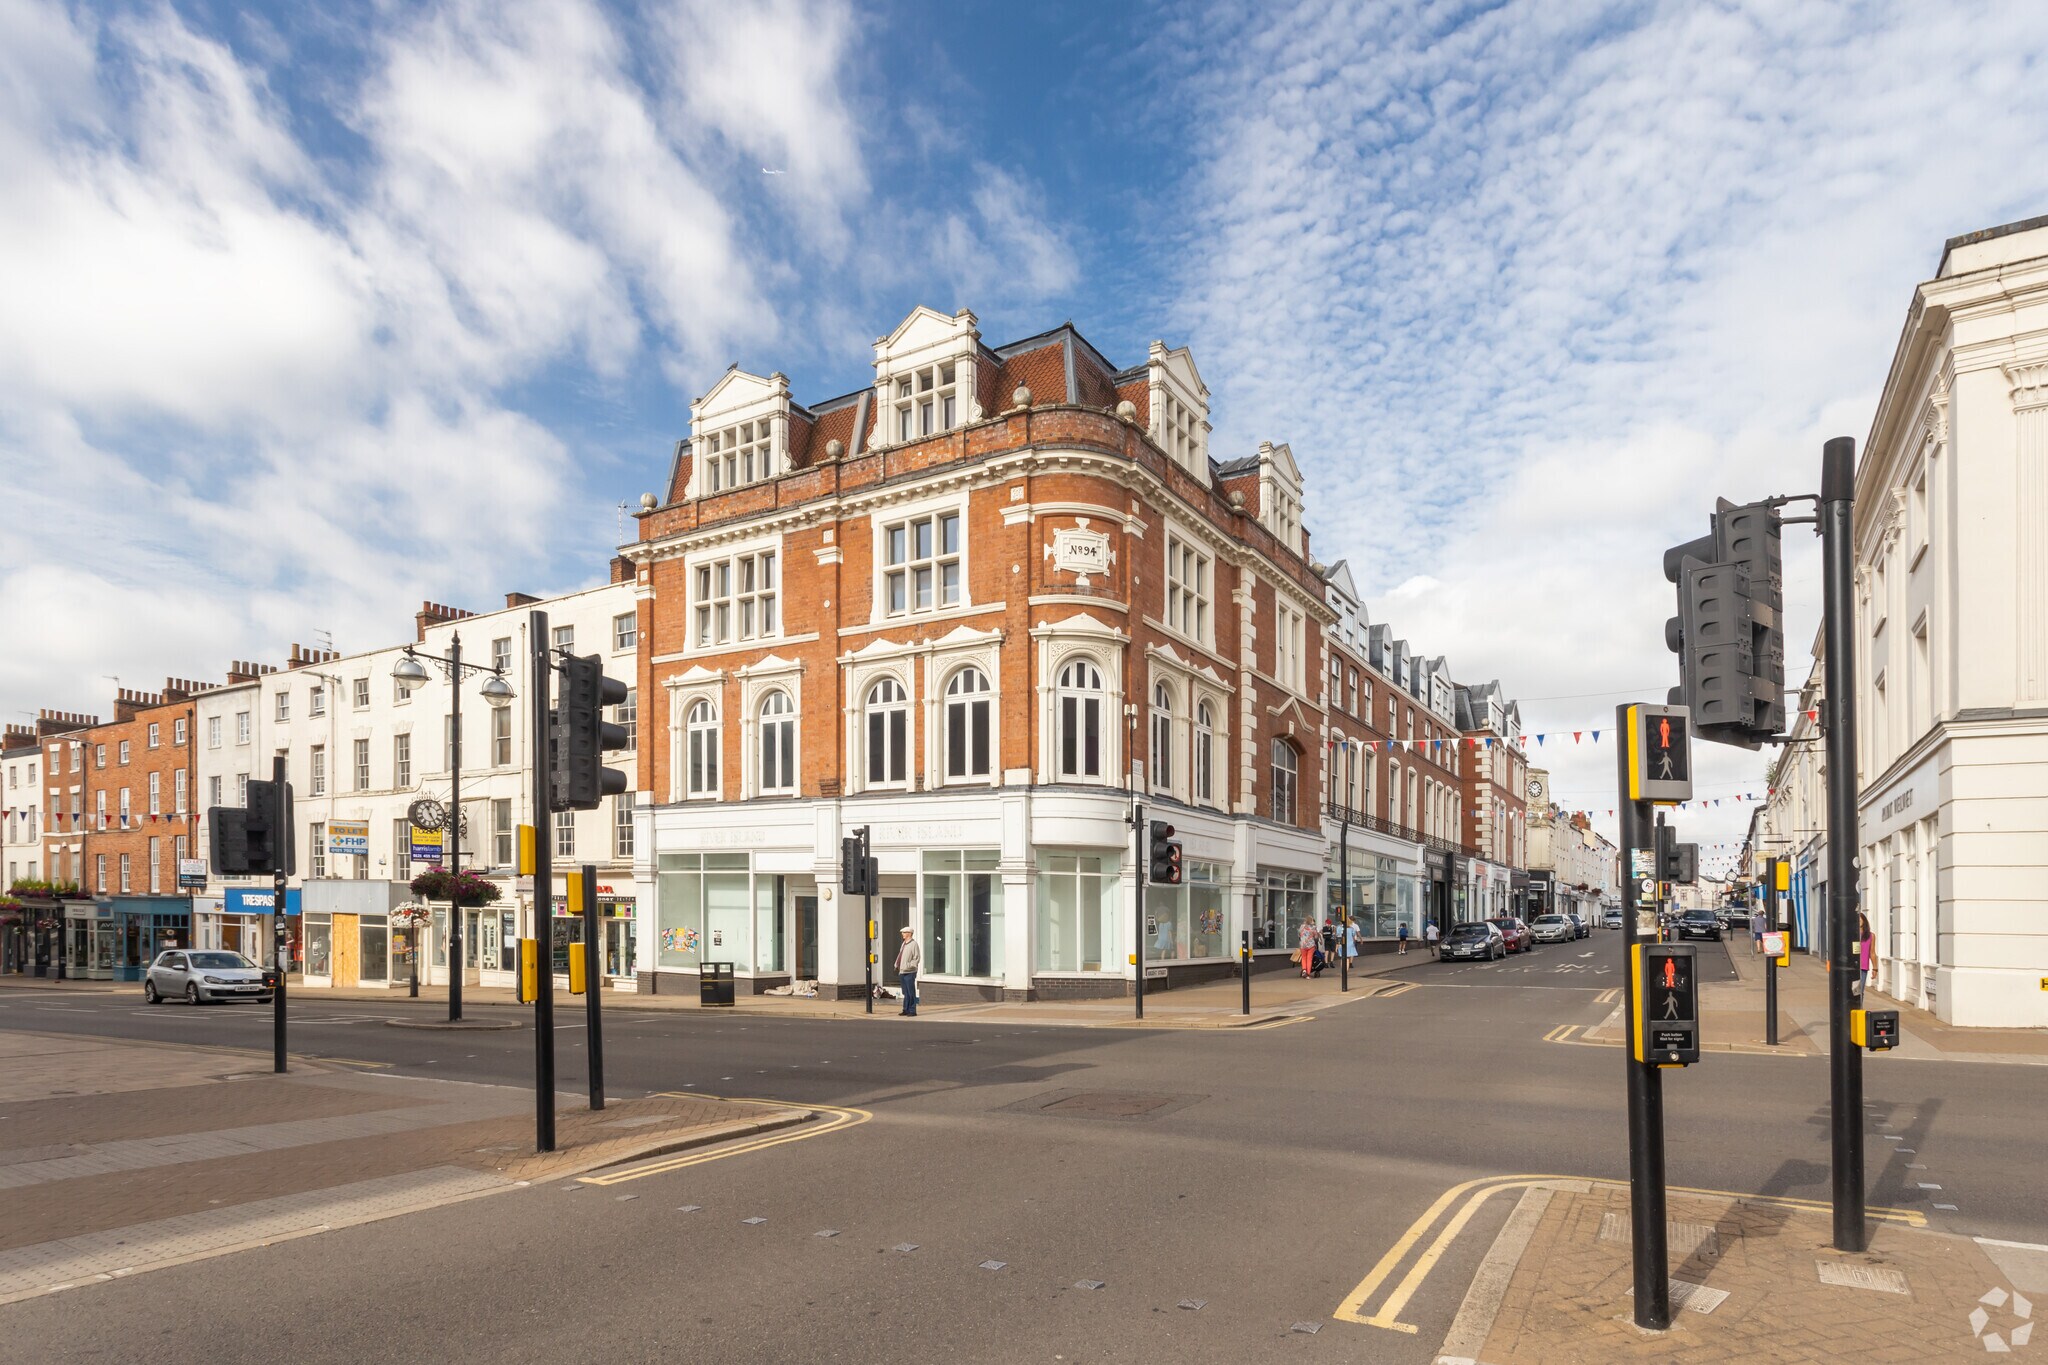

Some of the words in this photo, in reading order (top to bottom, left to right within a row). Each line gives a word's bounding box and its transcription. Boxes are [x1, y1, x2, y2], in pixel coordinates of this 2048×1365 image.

[1893, 788, 1913, 813] VELVET
[347, 827, 363, 835] LET
[345, 837, 366, 845] FHP
[241, 894, 275, 906] TRESPAS
